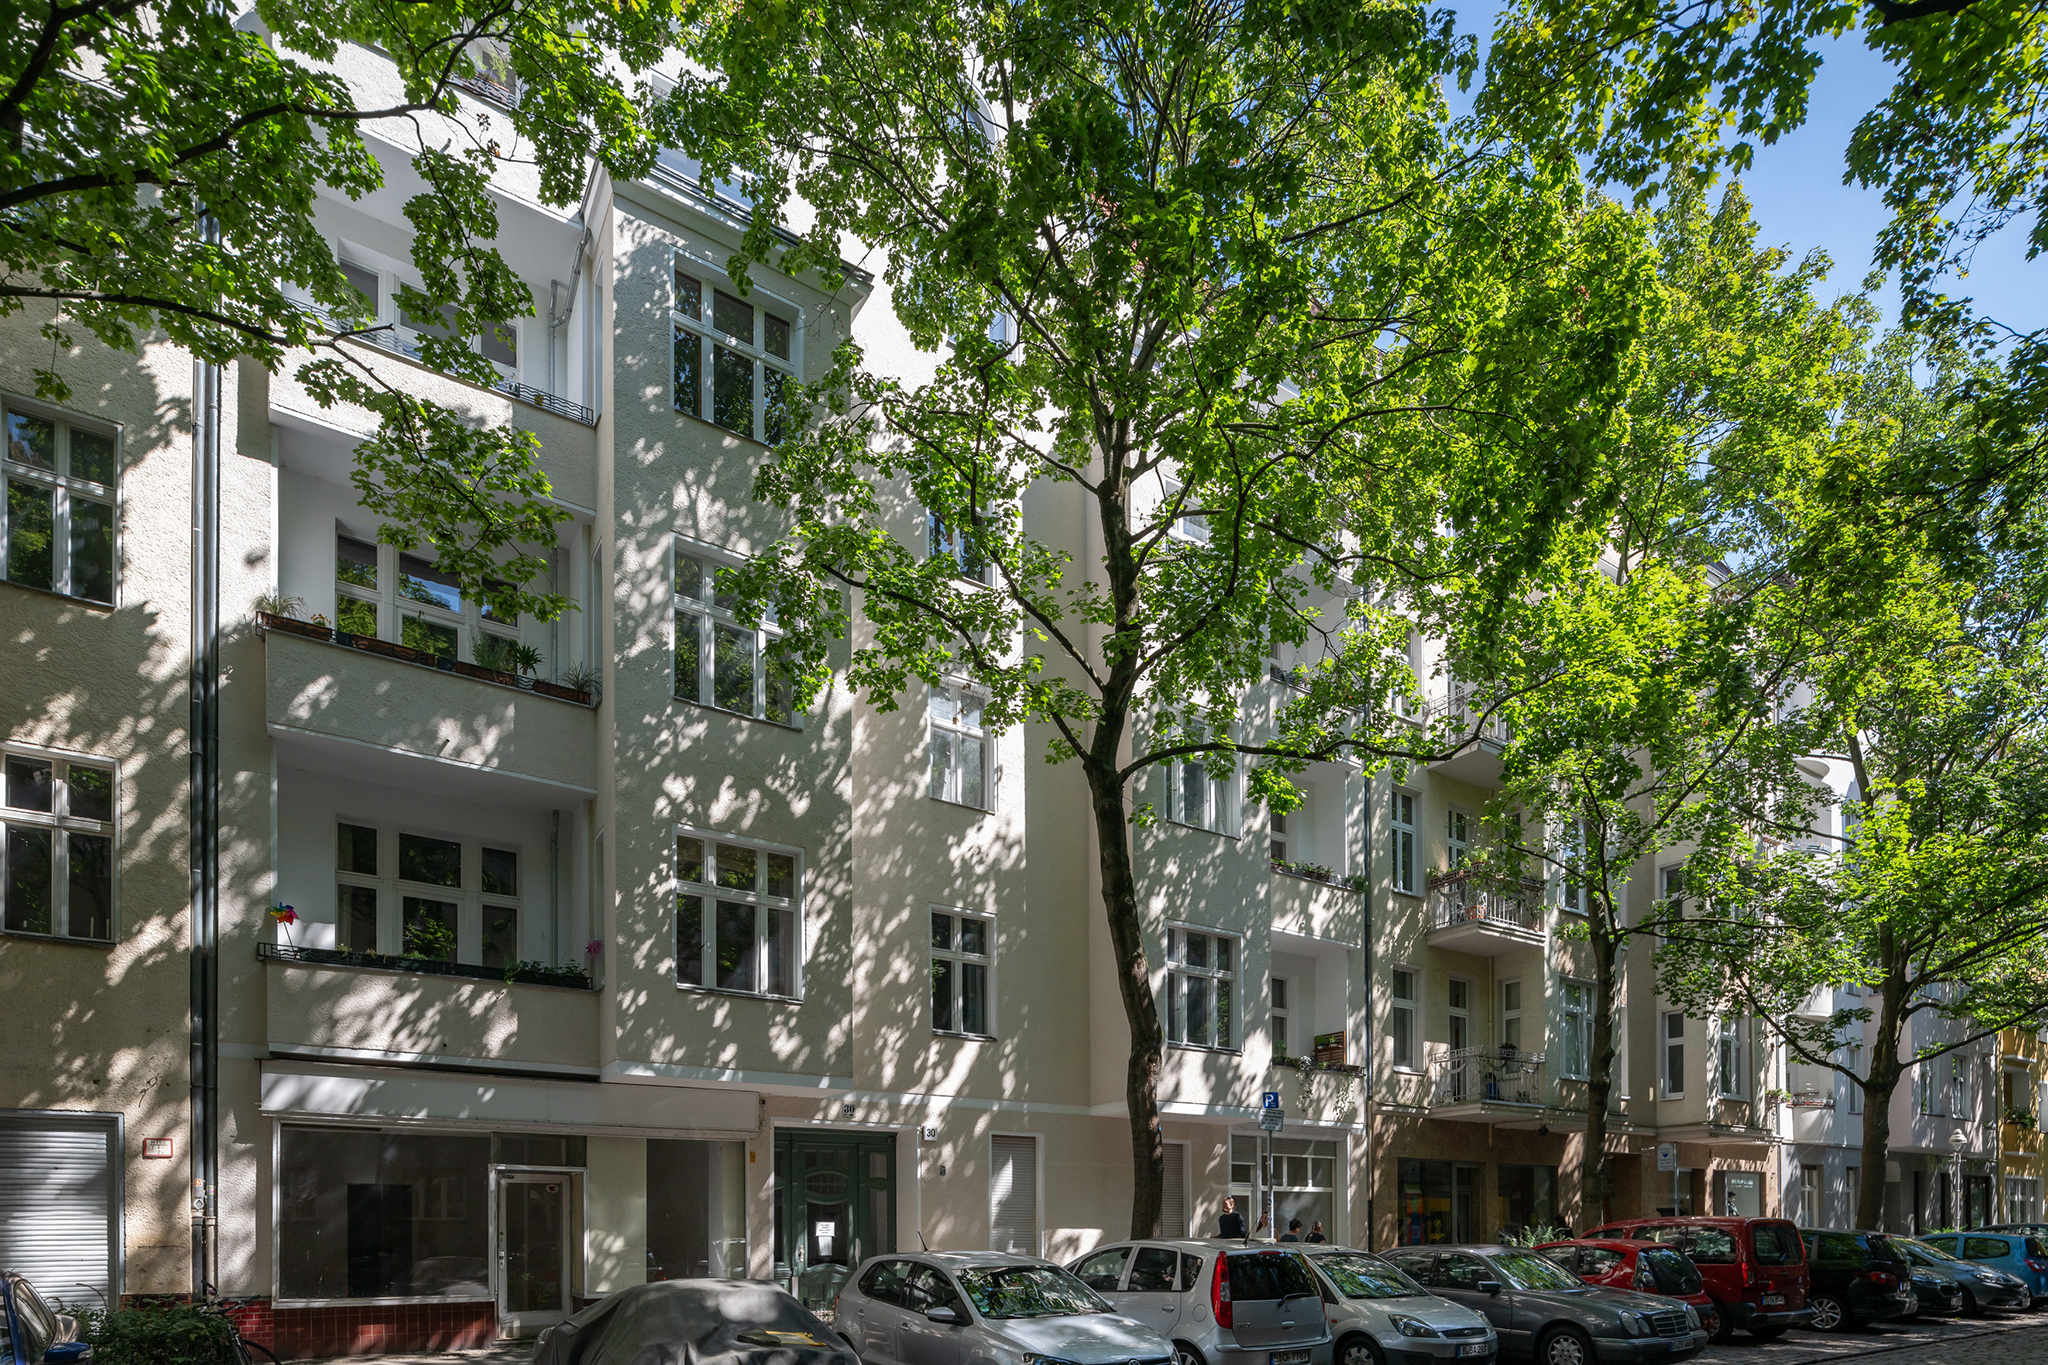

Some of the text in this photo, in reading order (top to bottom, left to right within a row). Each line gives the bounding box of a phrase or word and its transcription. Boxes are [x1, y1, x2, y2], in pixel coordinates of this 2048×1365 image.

[1265, 1094, 1274, 1107] P
[844, 1104, 855, 1113] 30
[926, 1128, 936, 1138] 30
